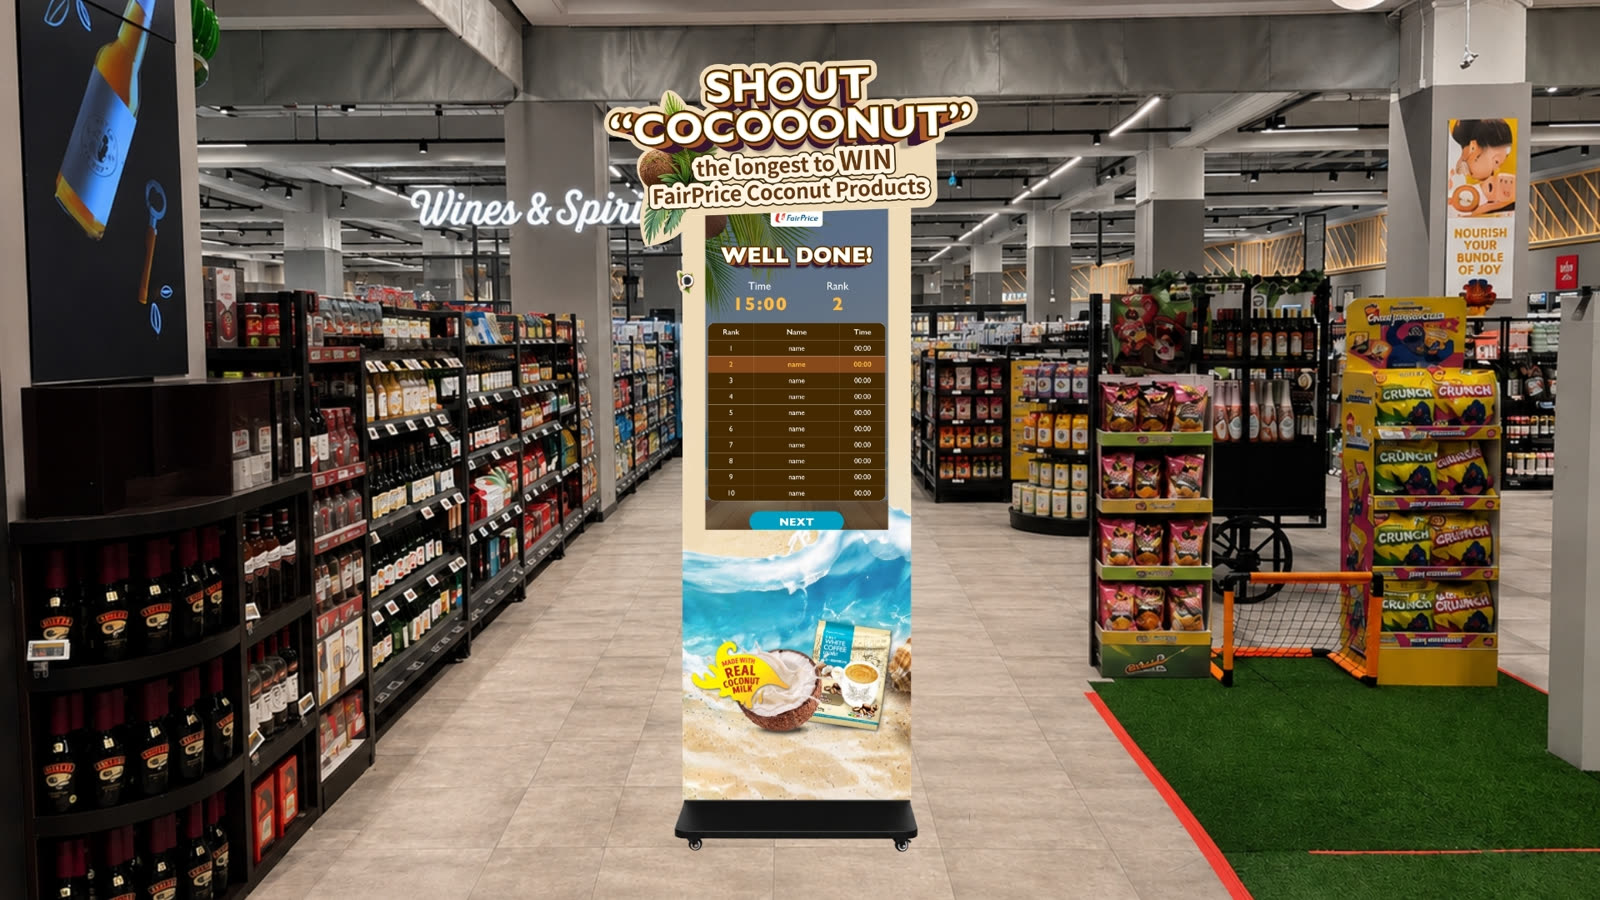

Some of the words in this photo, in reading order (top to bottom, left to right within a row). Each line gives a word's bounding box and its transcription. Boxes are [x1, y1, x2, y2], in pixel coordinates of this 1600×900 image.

[704, 64, 872, 108] SHOUT
[696, 158, 730, 177] the
[734, 156, 809, 180] longest
[813, 157, 835, 173] to
[838, 147, 892, 171] WIN
[653, 187, 742, 206] FairPrice
[746, 181, 831, 202] Coconut
[836, 177, 927, 199] Products
[410, 189, 522, 226] Wines
[526, 192, 552, 226] &
[786, 213, 819, 222] FairPrice
[1454, 227, 1507, 239] NOURISH
[1464, 240, 1497, 250] YOUR
[721, 246, 791, 268] WELL
[796, 246, 873, 268] DONE!
[1457, 252, 1503, 263] BUNDLE
[1458, 265, 1474, 275] OF
[1477, 264, 1502, 275] JOY
[748, 281, 772, 291] Time
[827, 281, 849, 291] Rank
[735, 296, 787, 311] 15:00
[832, 296, 843, 311] 2
[722, 328, 740, 336] Rank
[786, 328, 807, 336] Name
[853, 328, 872, 336] Time
[1382, 387, 1433, 401] CRUNCH
[1438, 383, 1493, 398] CRUNCH
[779, 517, 815, 527] NEXT
[1378, 530, 1430, 544] CRUNCH
[825, 638, 846, 646] WHITE
[823, 644, 848, 653] COFFEE
[721, 657, 739, 667] MADE
[724, 664, 756, 679] REAL
[722, 677, 760, 688] COCONUT
[732, 685, 753, 694] MILK
